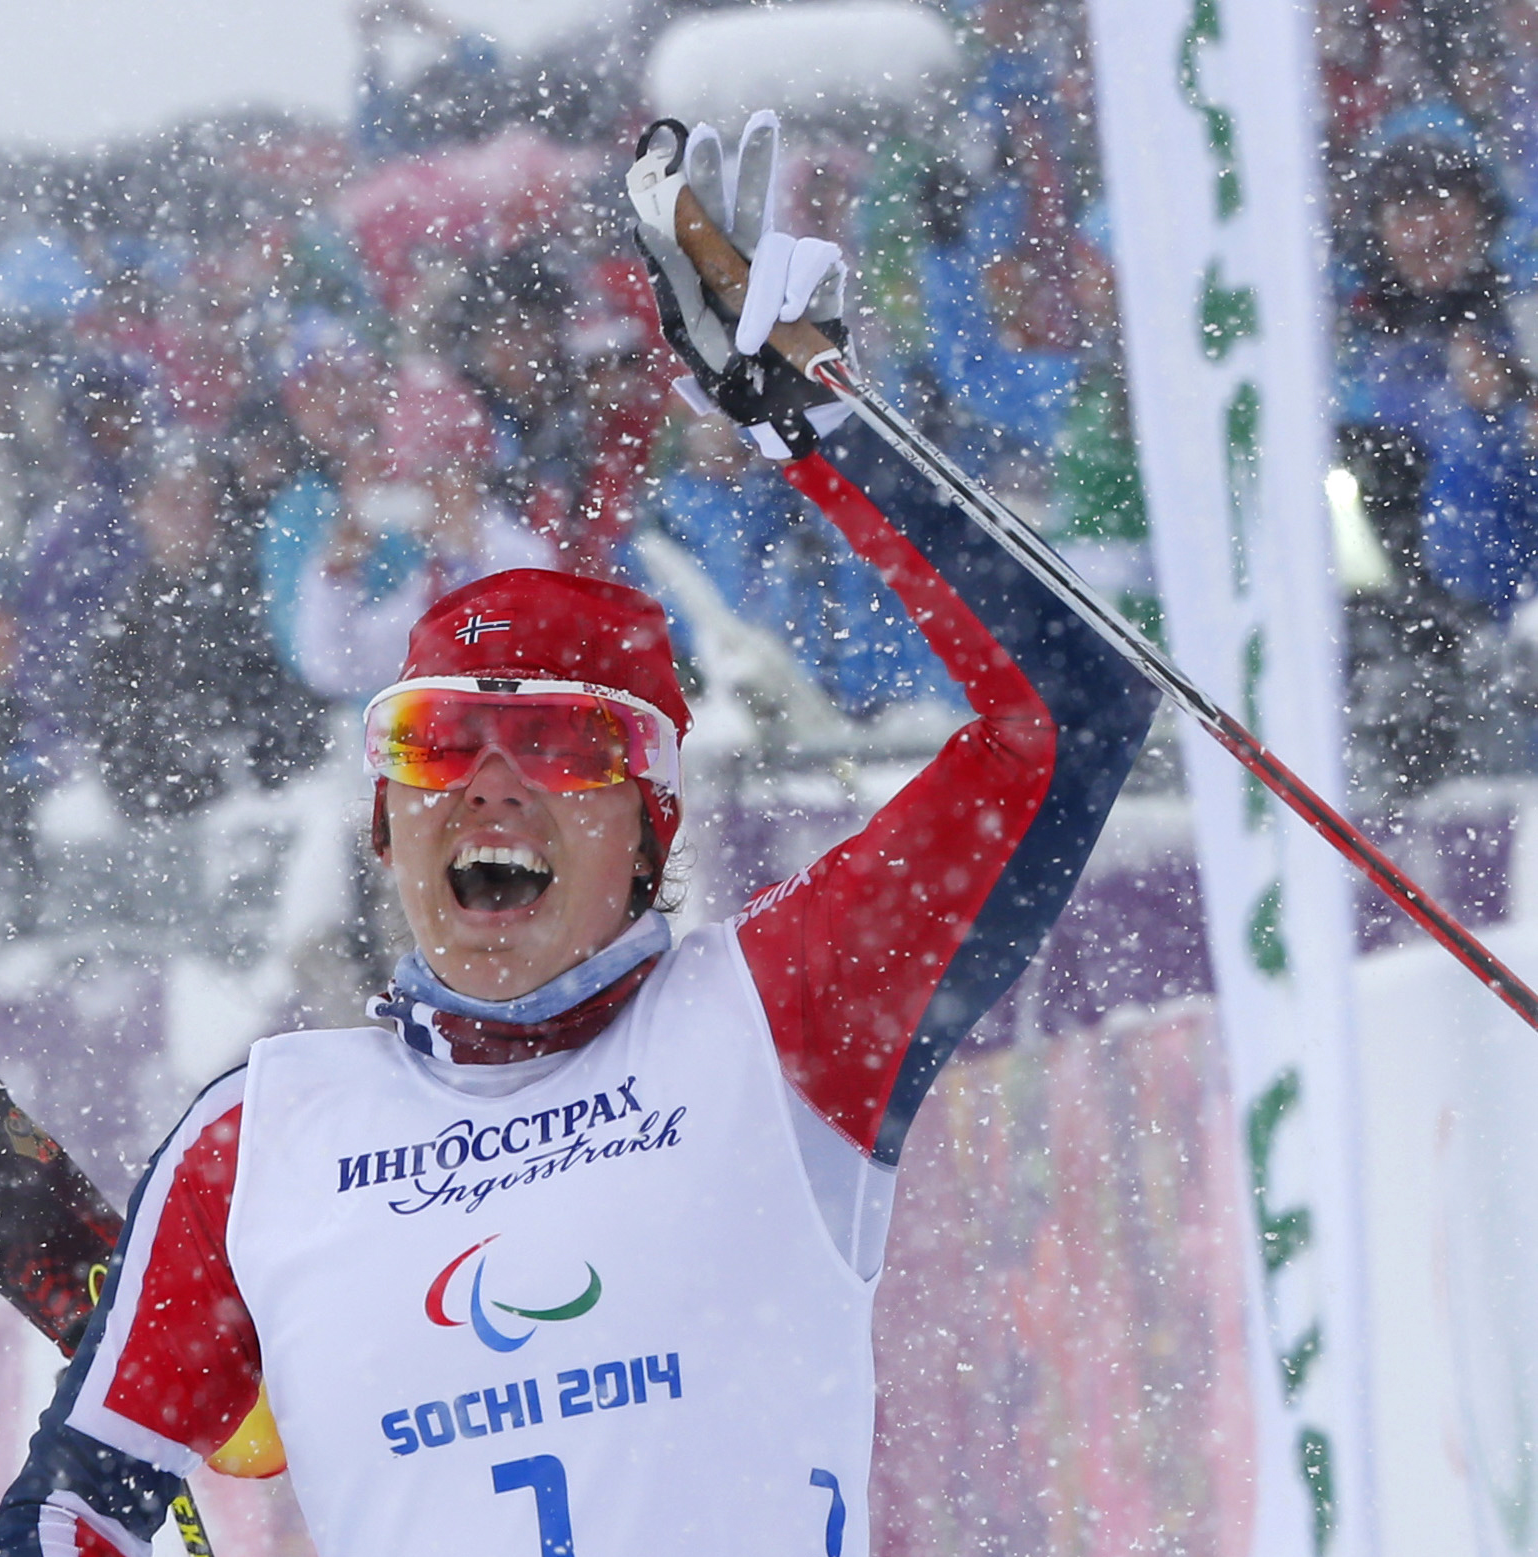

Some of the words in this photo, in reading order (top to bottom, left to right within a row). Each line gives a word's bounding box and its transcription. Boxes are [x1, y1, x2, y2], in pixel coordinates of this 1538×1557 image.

[336, 1075, 642, 1193] ИНГОССТРАХ
[388, 1105, 687, 1215] Ingosstrakh
[381, 1377, 542, 1457] SOCHI
[557, 1352, 682, 1417] 2014
